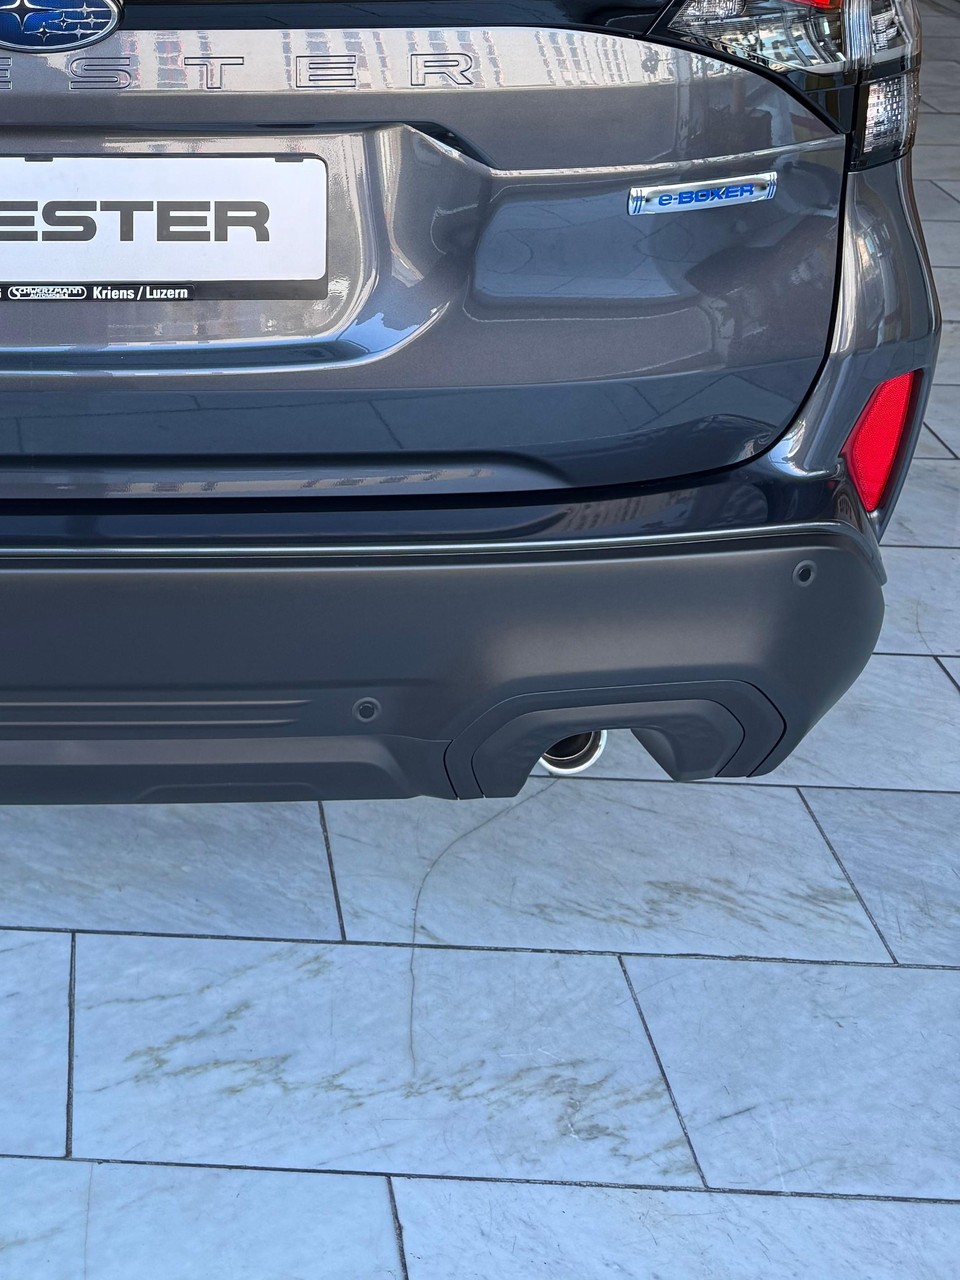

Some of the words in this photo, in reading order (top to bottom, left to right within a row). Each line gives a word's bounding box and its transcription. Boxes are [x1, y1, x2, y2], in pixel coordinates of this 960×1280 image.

[658, 183, 755, 207] e-BOXER
[93, 285, 134, 300] Kriens
[146, 286, 188, 300] Luzern
